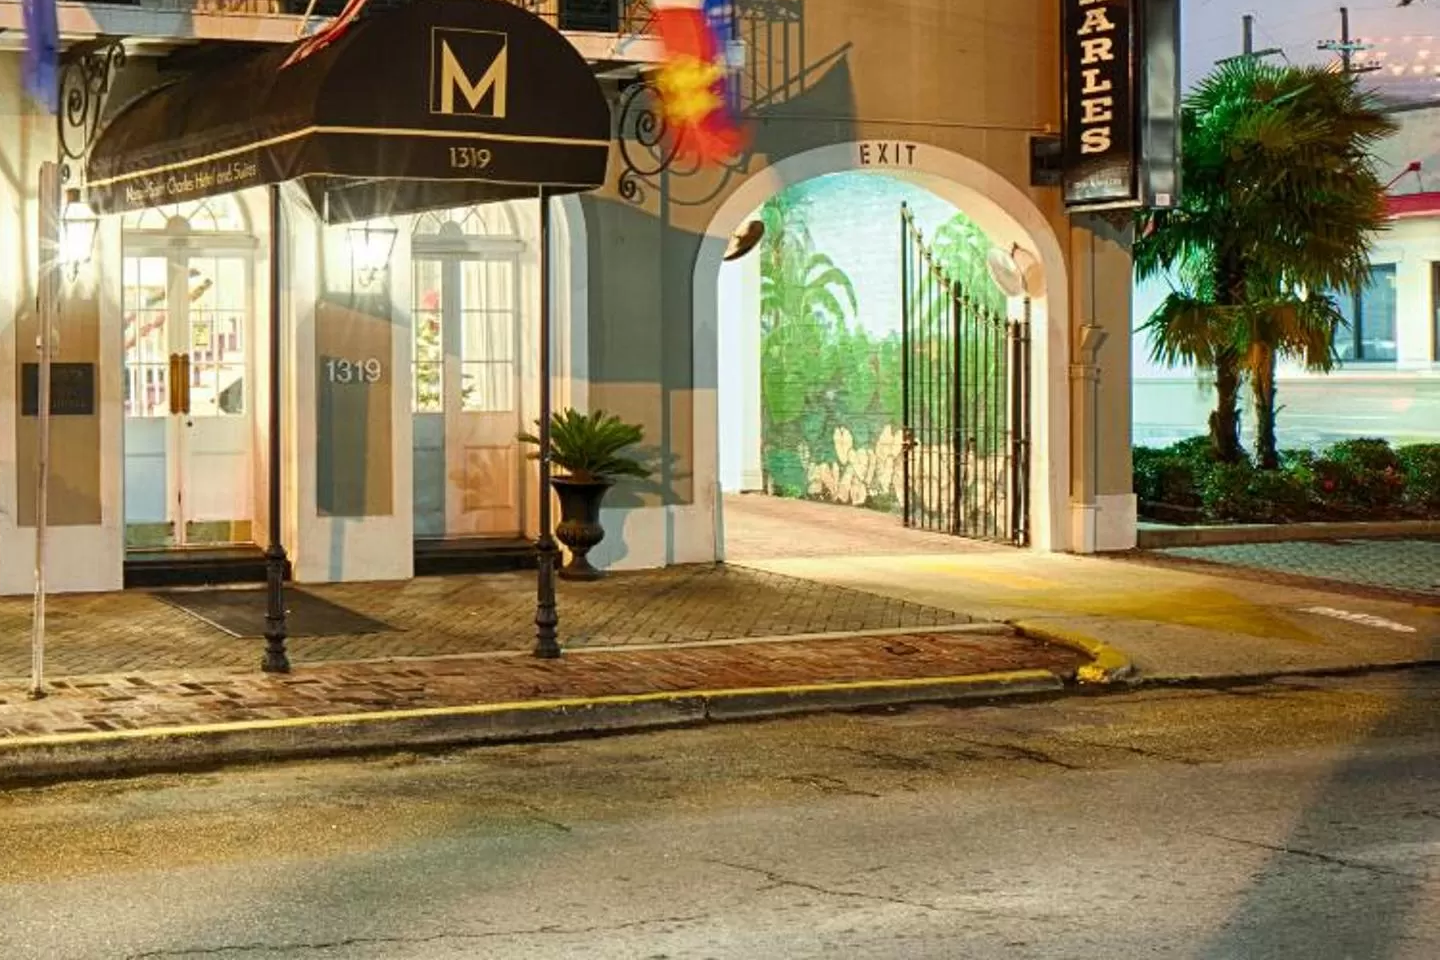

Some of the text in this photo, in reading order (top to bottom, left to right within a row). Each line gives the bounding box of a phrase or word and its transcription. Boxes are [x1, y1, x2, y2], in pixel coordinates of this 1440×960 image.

[441, 40, 507, 118] M
[449, 147, 491, 170] 1319
[859, 143, 916, 165] EXIT
[325, 358, 382, 384] 1319
